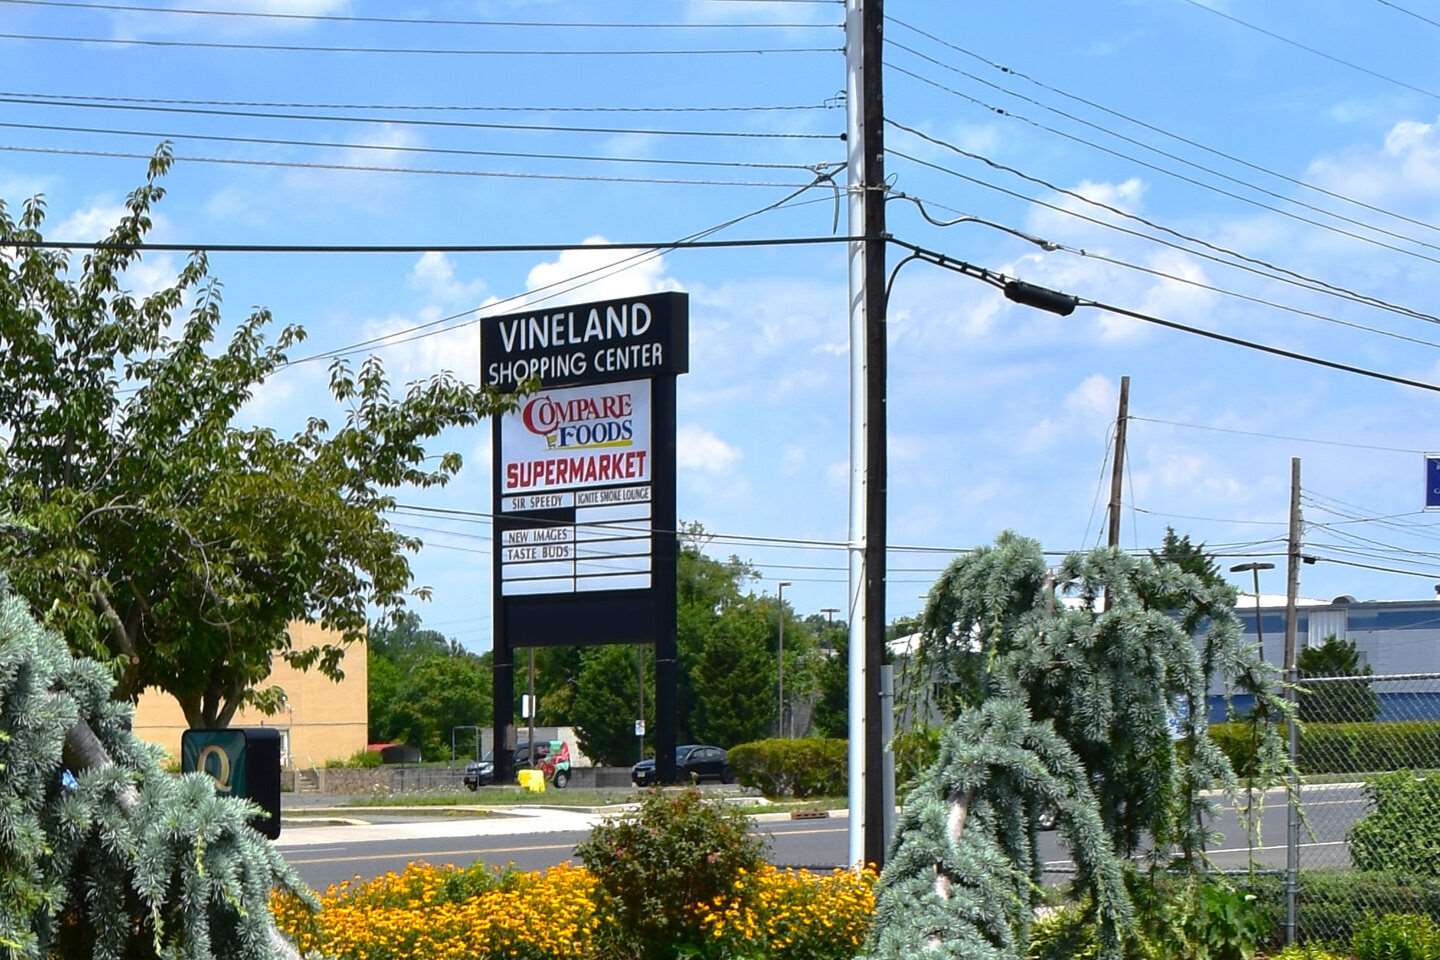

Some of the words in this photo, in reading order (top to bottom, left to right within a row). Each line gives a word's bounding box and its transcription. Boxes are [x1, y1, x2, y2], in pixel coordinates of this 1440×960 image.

[499, 303, 652, 353] VINELAND
[488, 352, 586, 385] SHOPPING
[594, 343, 663, 373] CENTER
[523, 394, 633, 436] COMPARE
[560, 420, 633, 447] FOODS
[506, 451, 647, 489] SUPERMARKET
[512, 497, 526, 510] SIR
[530, 495, 563, 509] SPEEDY
[507, 547, 537, 561] TASTE
[542, 545, 569, 558] BUDS
[508, 531, 529, 544] NEW
[534, 528, 568, 542] IMAGES
[197, 745, 232, 792] Q
